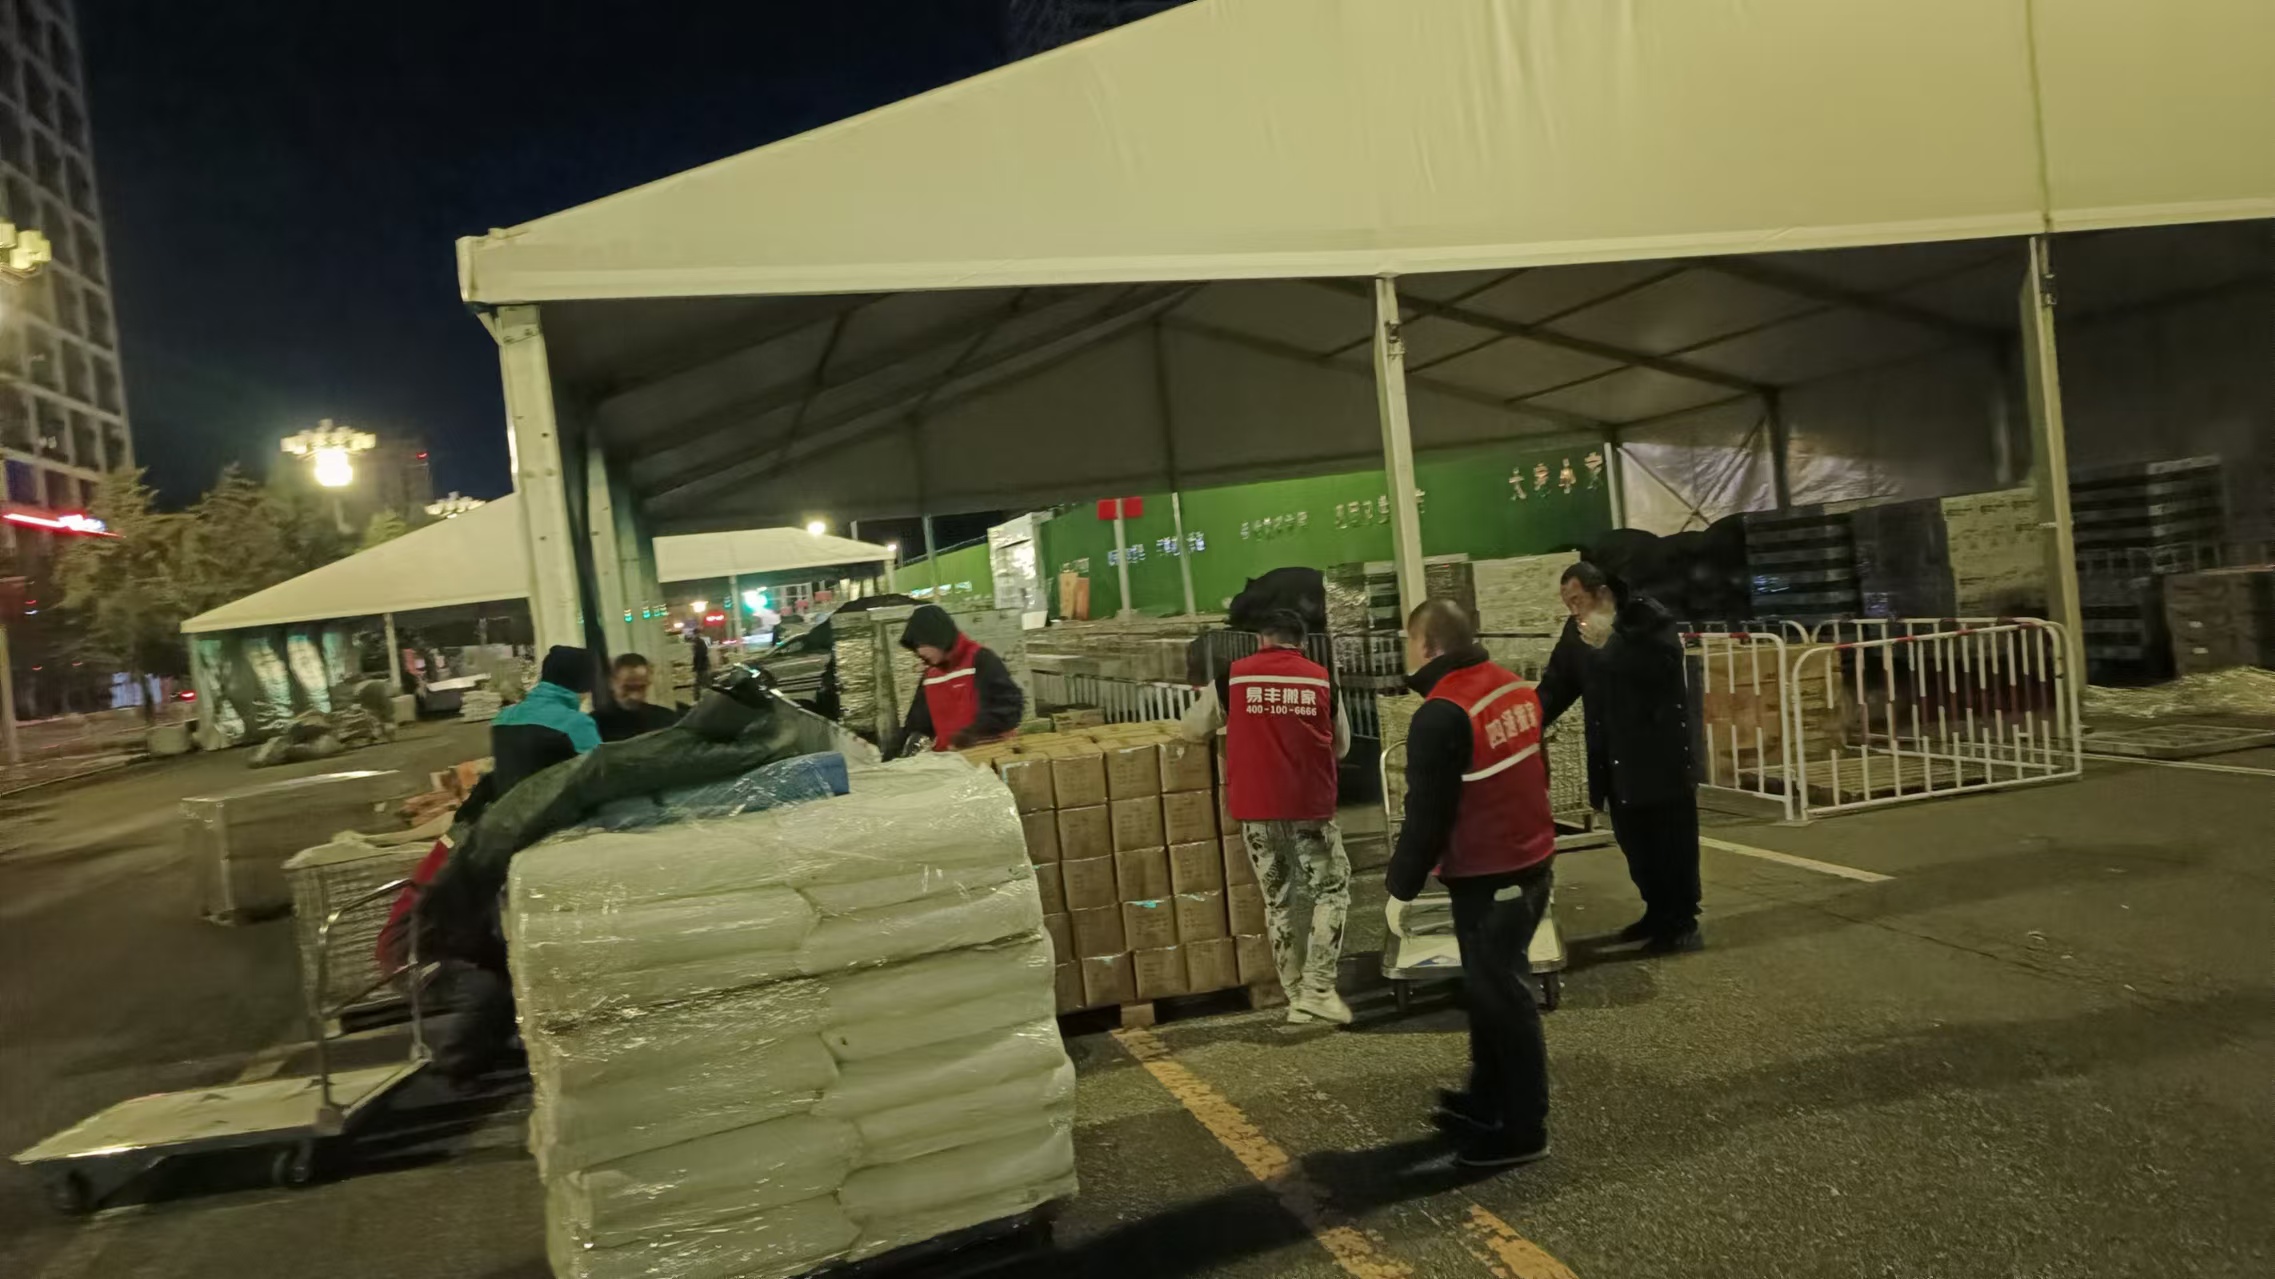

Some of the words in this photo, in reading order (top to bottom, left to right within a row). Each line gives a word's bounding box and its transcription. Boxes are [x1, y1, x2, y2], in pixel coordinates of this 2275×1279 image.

[1246, 687, 1316, 705] 易丰搬家
[1246, 705, 1317, 716] 400-100-6666
